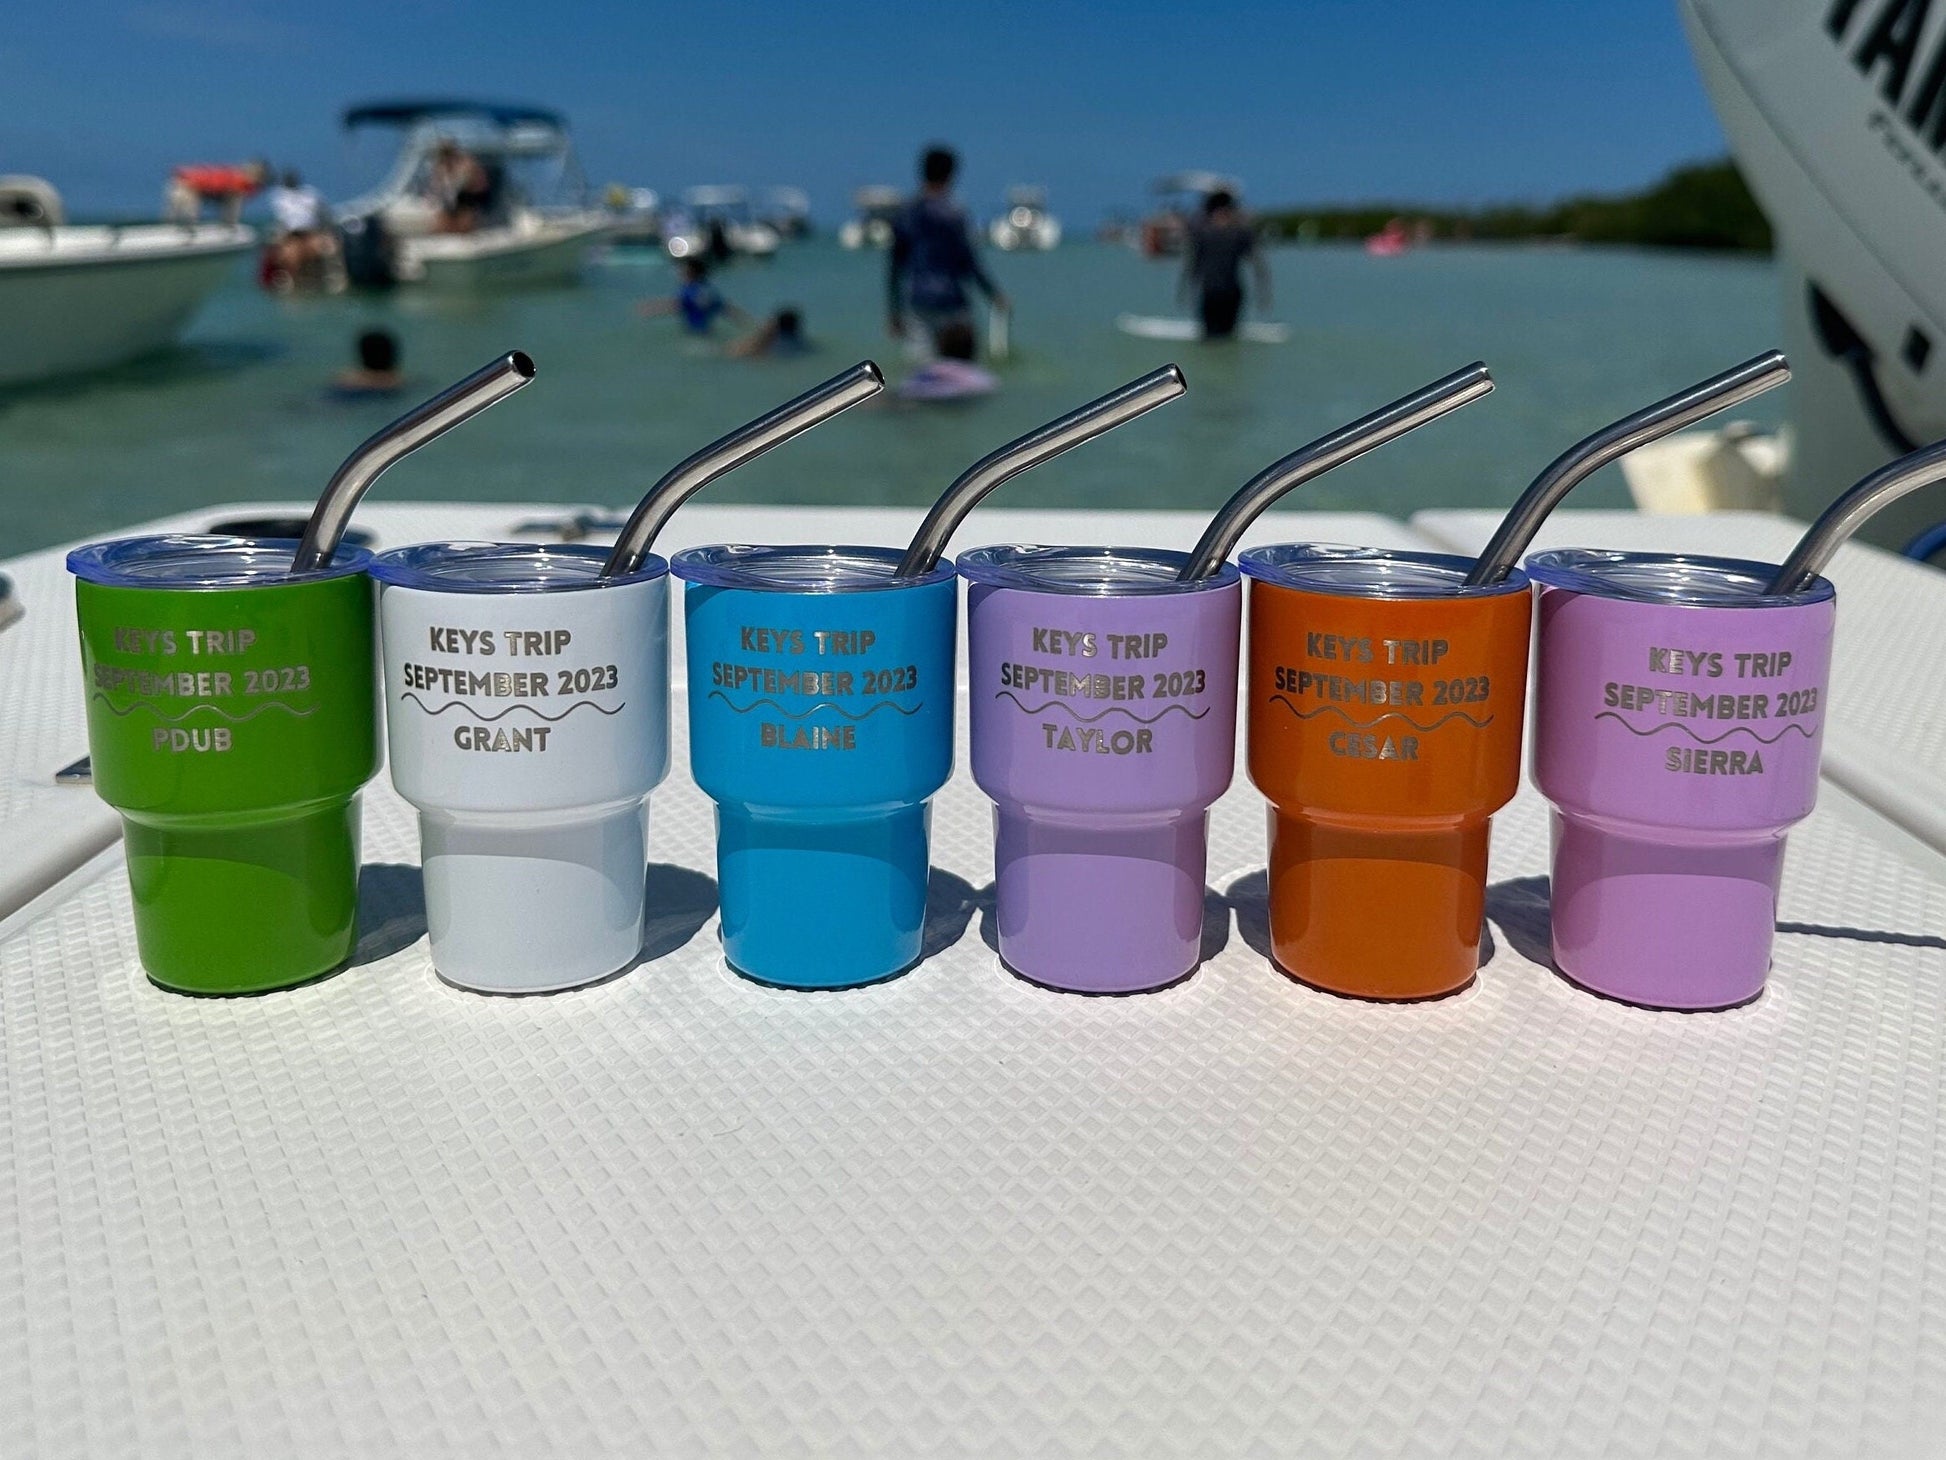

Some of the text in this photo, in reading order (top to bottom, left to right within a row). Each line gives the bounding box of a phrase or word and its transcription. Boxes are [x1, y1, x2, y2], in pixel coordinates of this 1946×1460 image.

[114, 626, 256, 655] KEYS TRIP
[430, 626, 572, 656] KEYS TRIP
[741, 626, 876, 655] KEYS TRIP
[1033, 627, 1168, 660] KEYS TRIP
[1307, 632, 1449, 665] KEYS TRIP
[1649, 646, 1792, 678] KEYS TRIP
[93, 663, 311, 697] SEPTEMBER 2023
[404, 662, 618, 697] SEPTEMBER 2023
[712, 661, 917, 696] SEPTEMBER 2023
[1001, 662, 1206, 701] SEPTEMBER 2023
[1275, 666, 1490, 706] SEPTEMBER 2023
[1604, 682, 1818, 719] SEPTEMBER 2023
[153, 727, 233, 752] PDUB
[454, 726, 551, 752] GRANT
[760, 722, 856, 750] BLAINE
[1042, 723, 1153, 755] TAYLOR
[1328, 731, 1420, 761] CESAR
[1665, 746, 1764, 775] SIERRA
